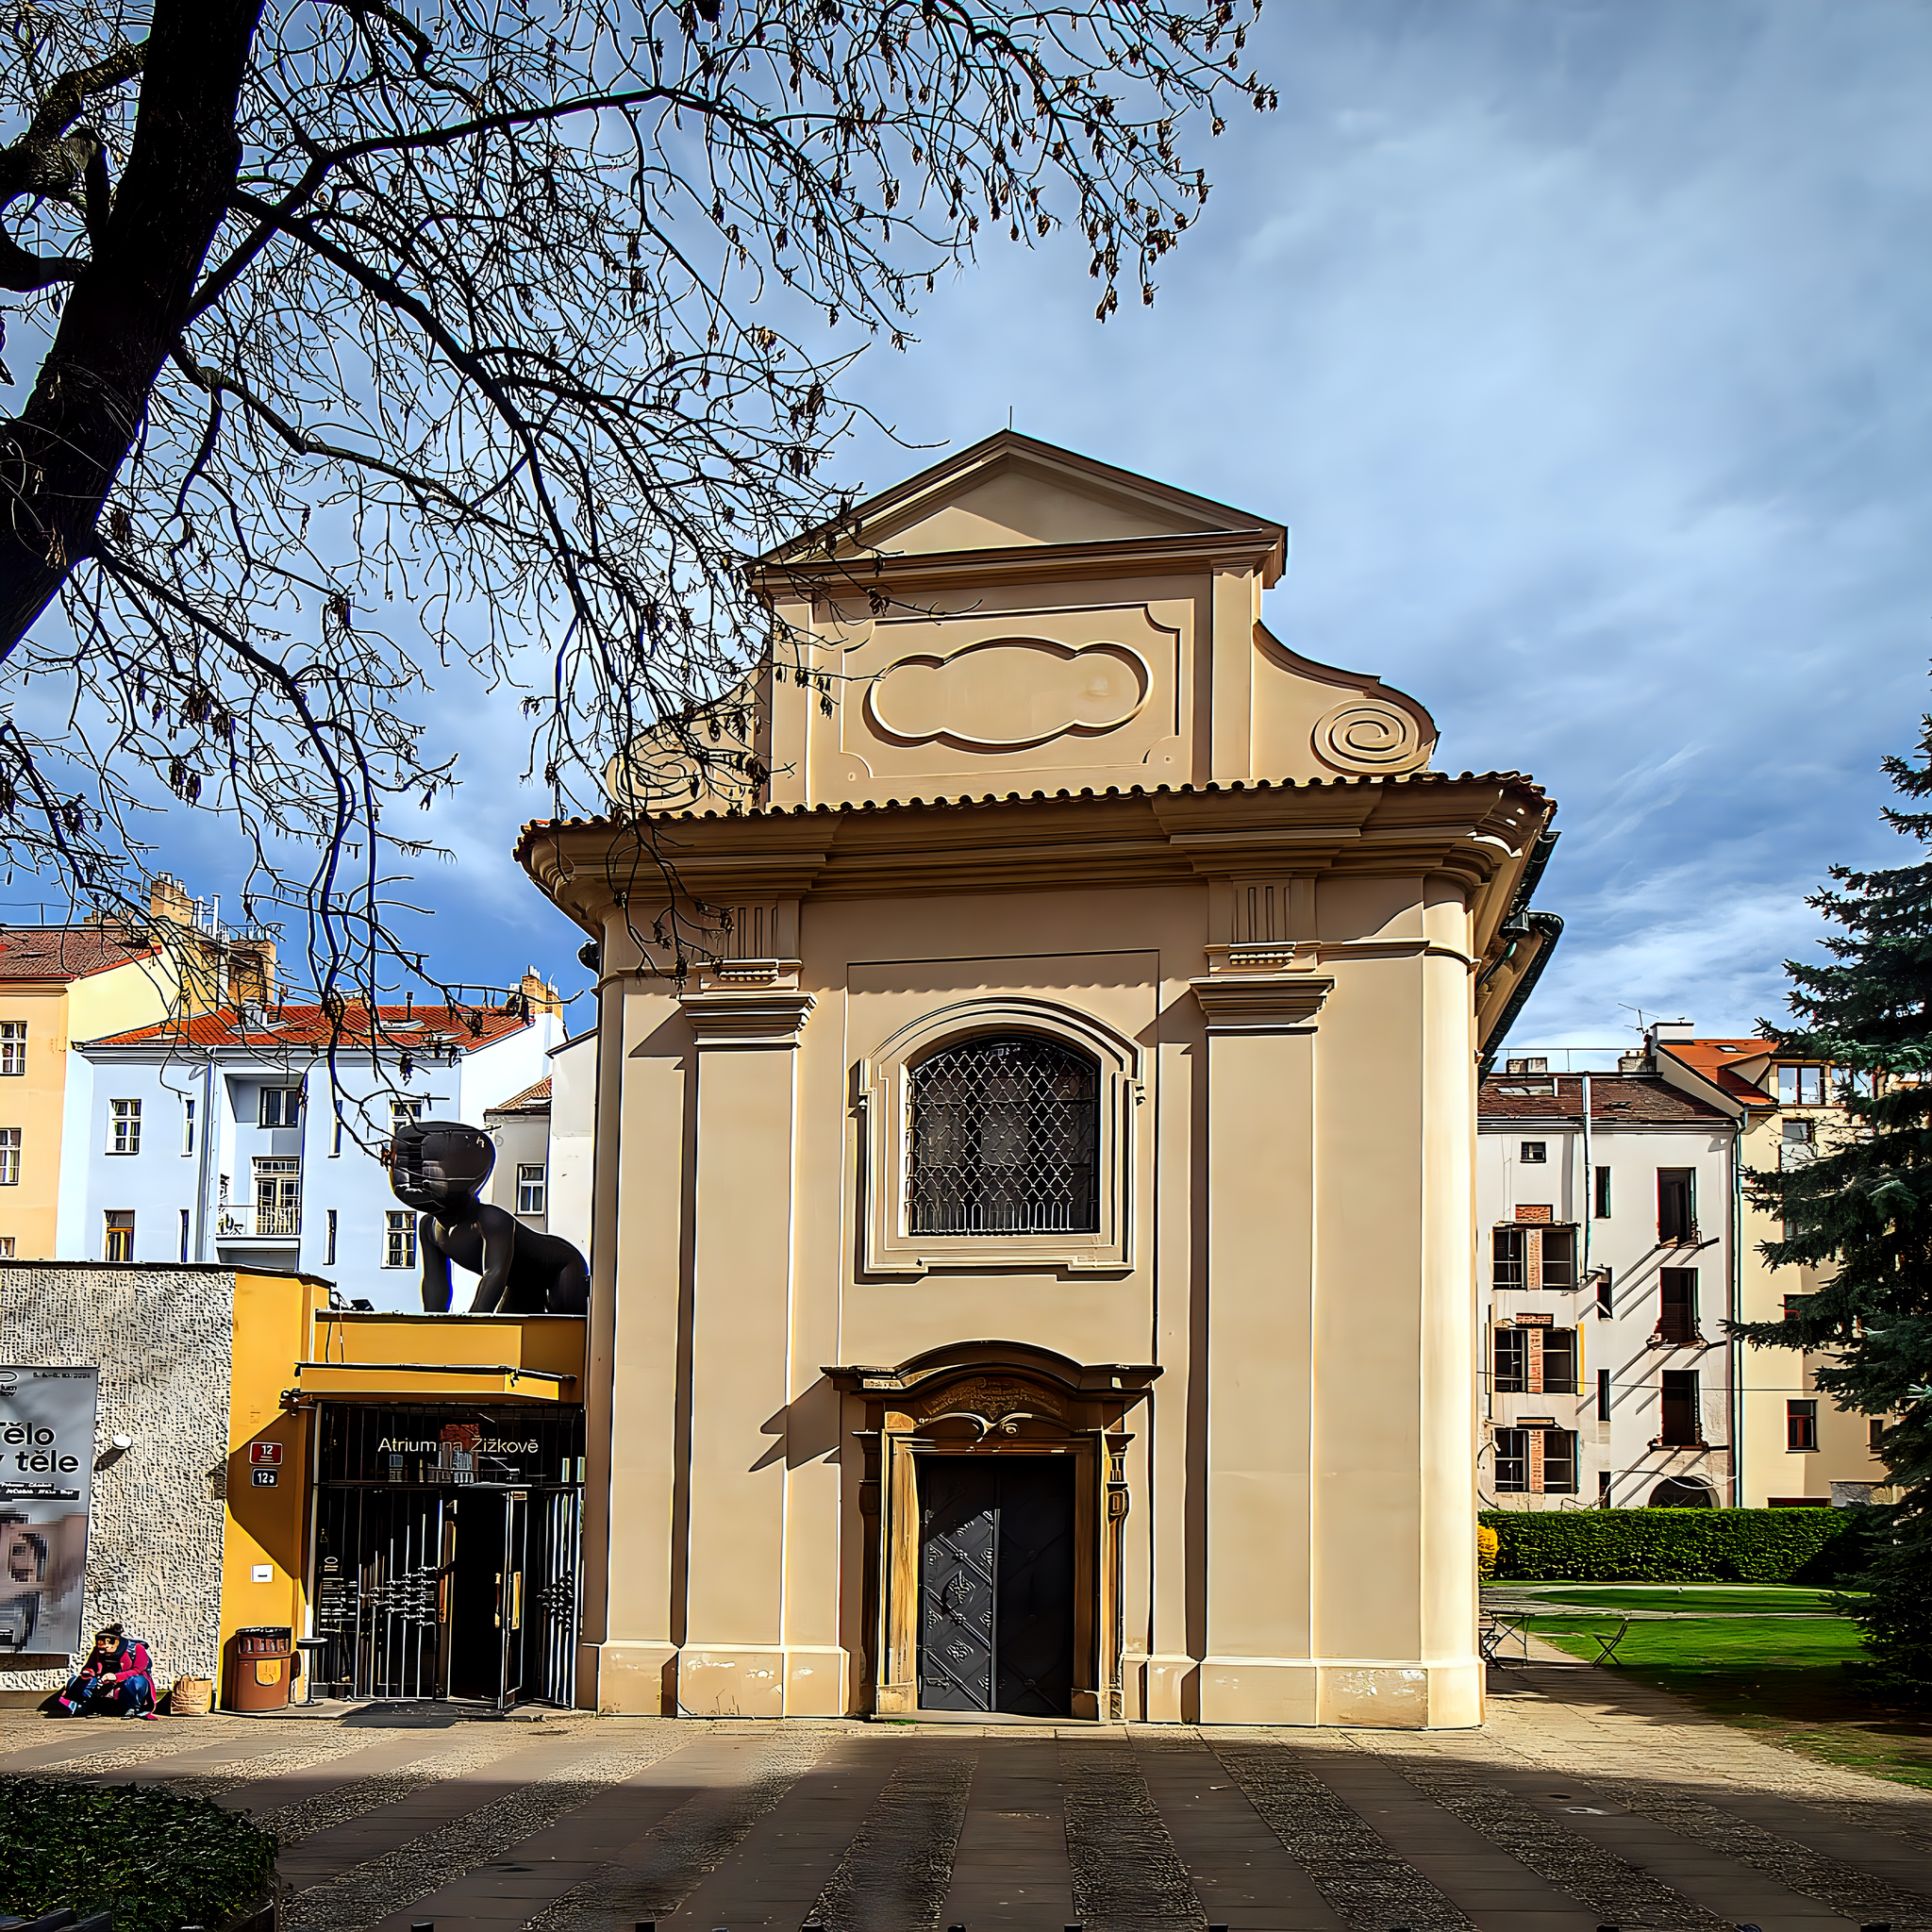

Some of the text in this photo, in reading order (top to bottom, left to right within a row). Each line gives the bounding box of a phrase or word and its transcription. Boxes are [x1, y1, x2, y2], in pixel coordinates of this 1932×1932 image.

[261, 1444, 274, 1455] 12
[377, 1438, 437, 1452] Atrium
[441, 1441, 463, 1452] na
[14, 1449, 79, 1474] těle
[257, 1472, 275, 1484] 12a
